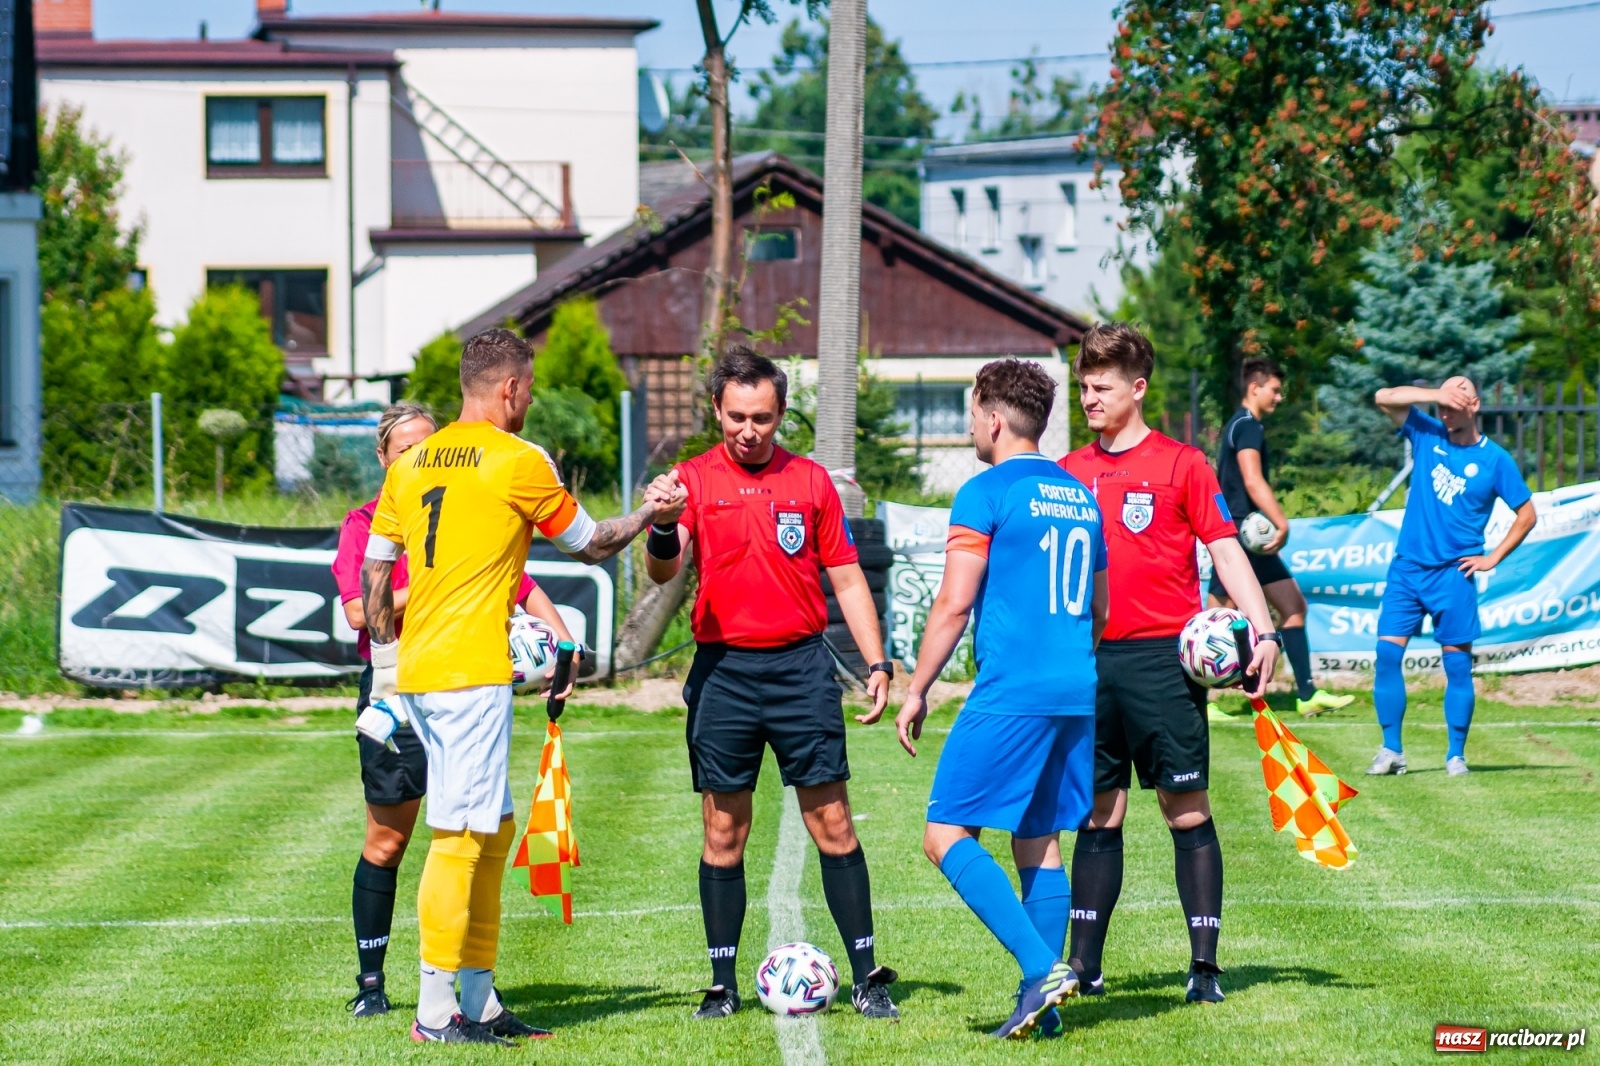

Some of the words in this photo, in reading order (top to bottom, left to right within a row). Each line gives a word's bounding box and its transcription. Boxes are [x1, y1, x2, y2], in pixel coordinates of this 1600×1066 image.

[413, 446, 484, 468] M.KUHN
[1037, 483, 1089, 504] FORTECA
[421, 486, 447, 568] 1
[1039, 525, 1091, 616] 10
[1291, 541, 1394, 573] SZYBKI
[1319, 658, 1341, 670] 32
[1347, 658, 1378, 670] 70
